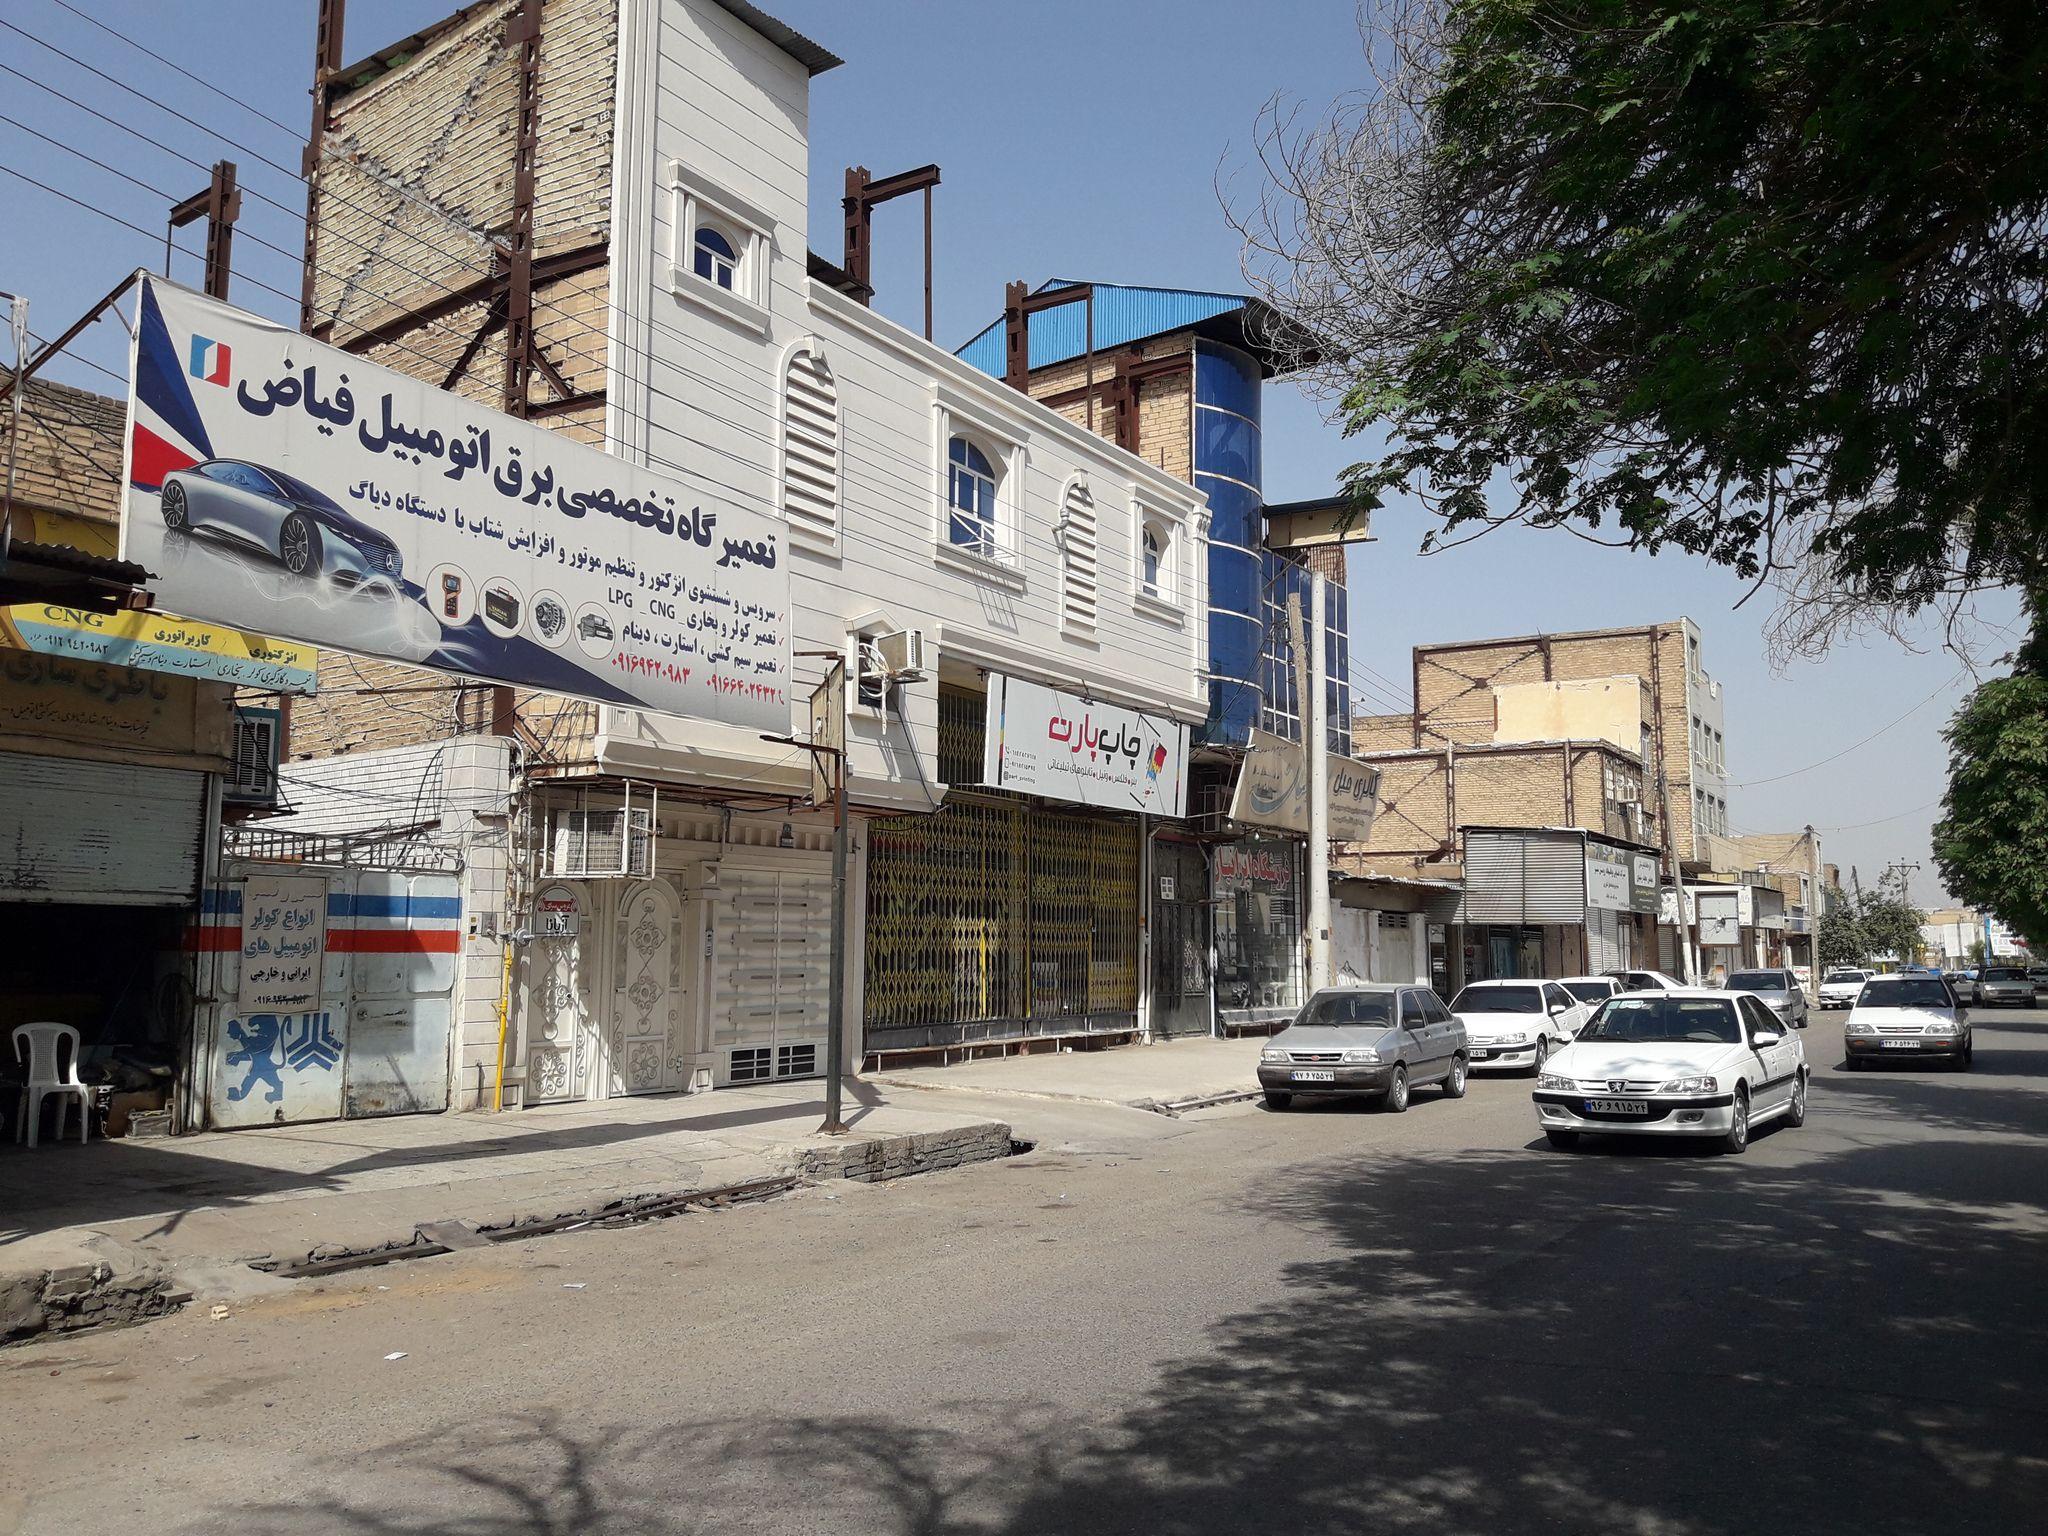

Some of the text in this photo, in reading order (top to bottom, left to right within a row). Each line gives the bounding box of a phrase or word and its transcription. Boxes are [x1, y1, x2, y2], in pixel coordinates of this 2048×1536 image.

[237, 358, 777, 570] تعمیر گاه تخصصی برق اتومبیل فیاض
[348, 480, 776, 623] سرویس و شستشوی انژکتور و تنظیم موتور و افزایش شتاب با دستگاه دیاگ
[44, 606, 298, 664] انژکتوری کاربراتوری CNG
[608, 587, 776, 646] تعمیر کولر و بخاری CNG LPG
[622, 620, 777, 674] تعمیر سیم کشی استارت دینام
[1048, 713, 1141, 771] چاپ پارت
[250, 966, 311, 982] ایرانی و خارجی
[1614, 1101, 1633, 1112] ۹۱۵
